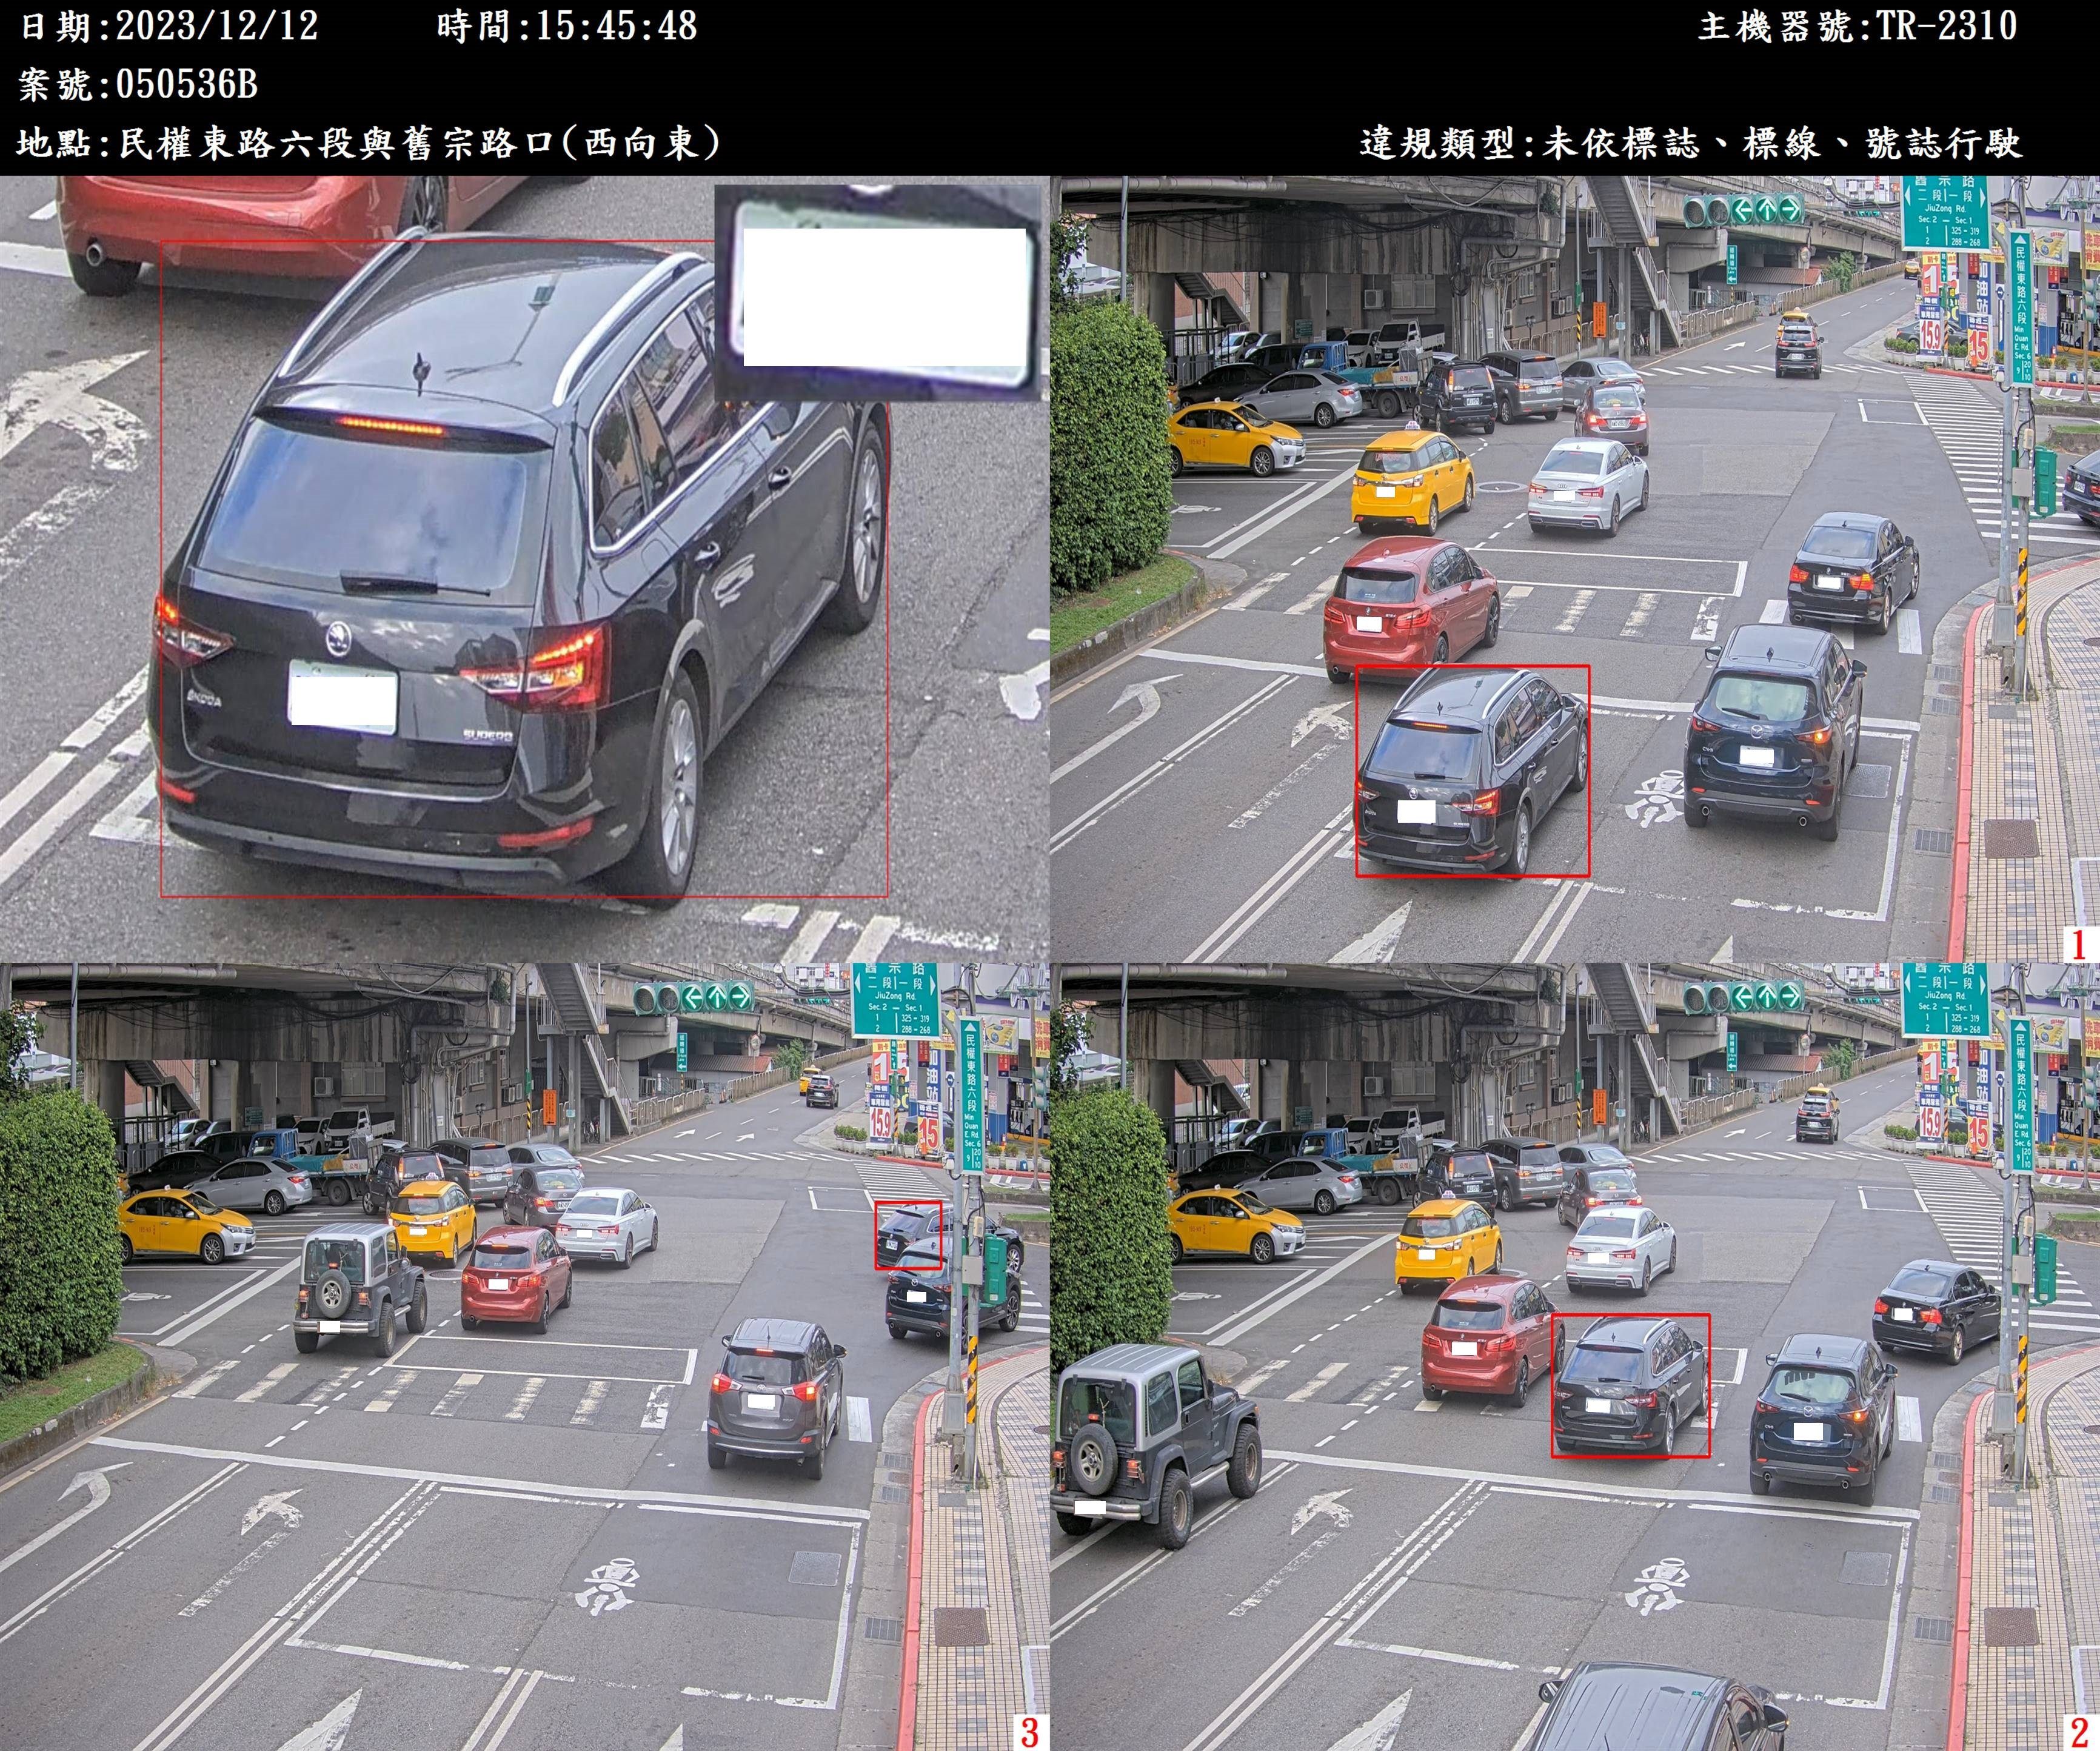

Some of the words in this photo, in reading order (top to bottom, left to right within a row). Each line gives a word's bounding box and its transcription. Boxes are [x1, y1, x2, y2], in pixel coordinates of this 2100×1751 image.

[1925, 204, 1952, 214] JiuZong
[1956, 204, 1966, 213] Rd.
[1925, 236, 1930, 245] 2
[2016, 247, 2027, 324] 民權東路六段
[1921, 320, 1941, 349] 15.9
[1969, 331, 1988, 360] 15
[875, 991, 902, 1002] JiuZong
[906, 992, 916, 1000] Rd.
[1925, 991, 1952, 1001] JiuZong
[1956, 991, 1966, 1000] Rd.
[875, 1024, 880, 1033] 2
[1925, 1023, 1930, 1032] 2
[966, 1034, 977, 1111] 民權東路六段
[2016, 1034, 2027, 1111] 民權東路六段
[871, 1108, 891, 1137] 15.9
[919, 1119, 938, 1148] 15
[1921, 1107, 1941, 1136] 15.9
[1969, 1118, 1988, 1147] 15
